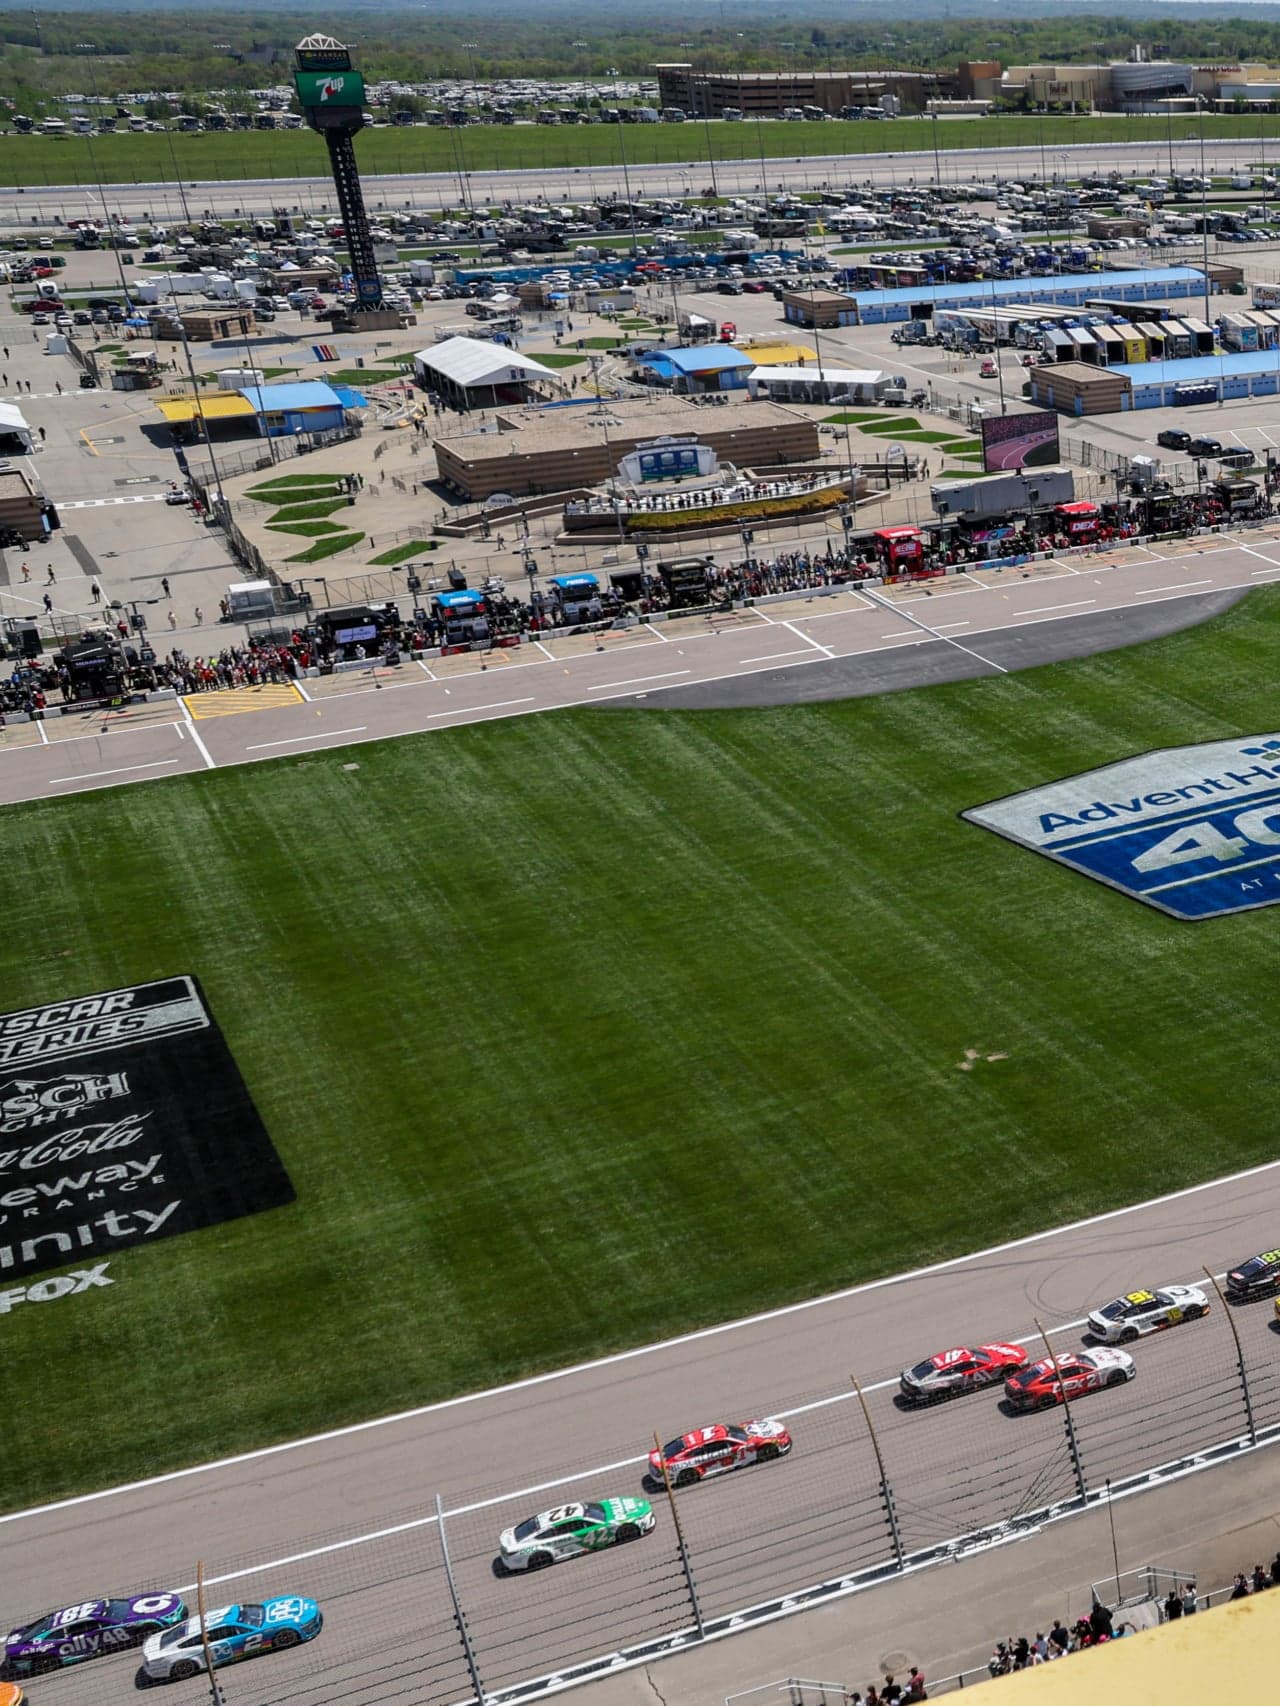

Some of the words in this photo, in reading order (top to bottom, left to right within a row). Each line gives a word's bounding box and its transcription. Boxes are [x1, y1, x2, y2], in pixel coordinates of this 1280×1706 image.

[1072, 521, 1096, 531] DEX
[1239, 878, 1264, 892] AT
[0, 992, 136, 1035] SCAR
[0, 1013, 149, 1059] ERIES
[0, 1261, 116, 1314] FOX
[943, 1349, 964, 1364] 41
[972, 1369, 992, 1383] 41
[1052, 1379, 1085, 1393] DEX
[548, 1505, 578, 1522] 42
[582, 1526, 611, 1546] 42
[59, 1634, 101, 1656] ally
[102, 1627, 130, 1644] 48
[244, 1633, 263, 1652] 2
